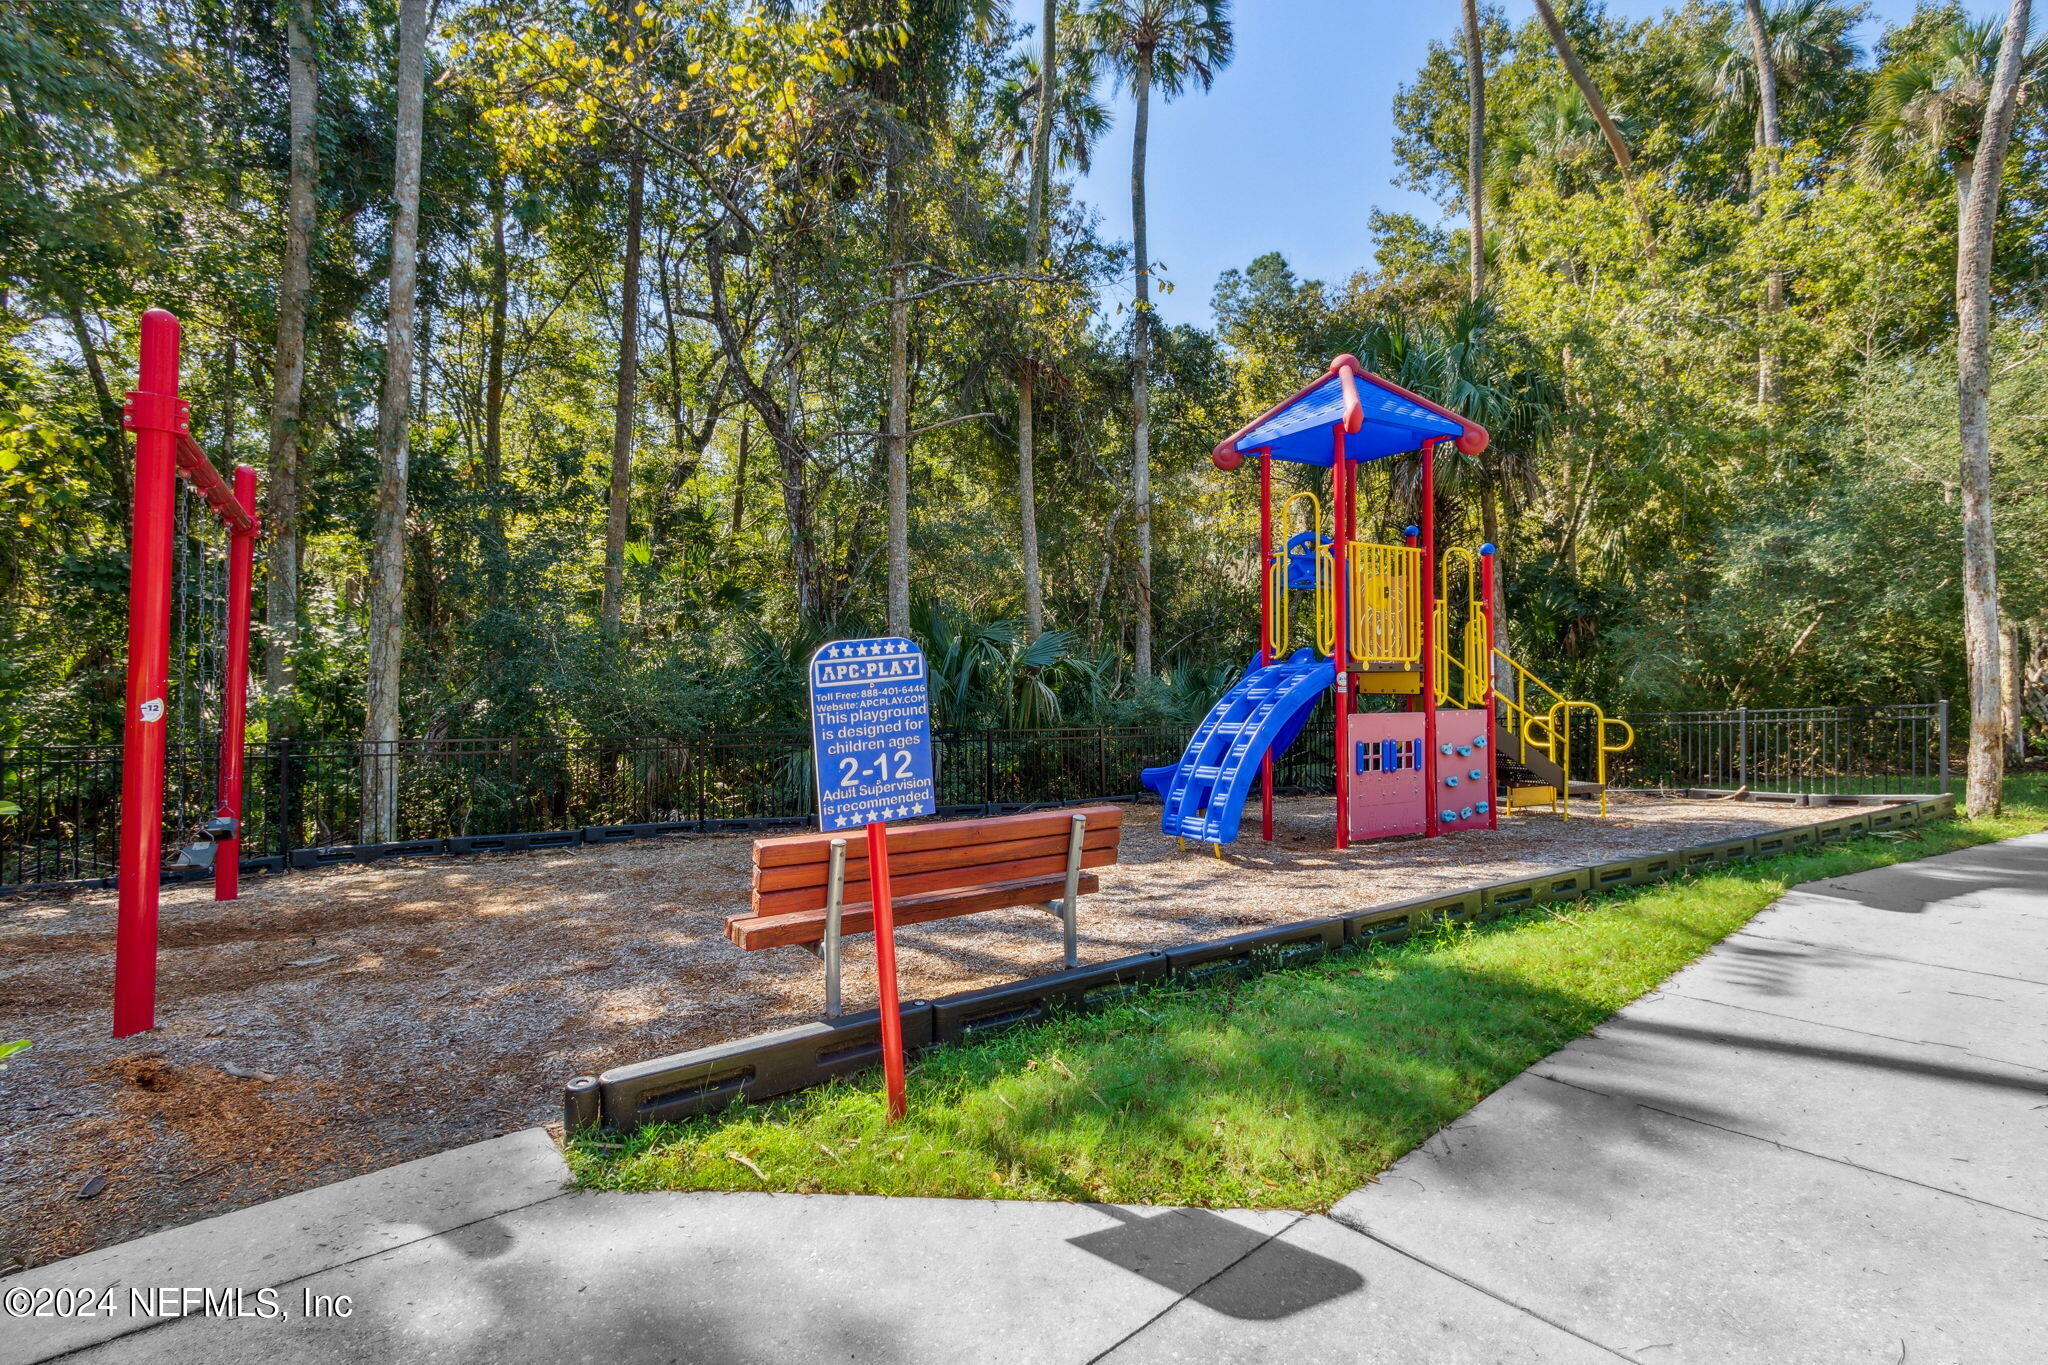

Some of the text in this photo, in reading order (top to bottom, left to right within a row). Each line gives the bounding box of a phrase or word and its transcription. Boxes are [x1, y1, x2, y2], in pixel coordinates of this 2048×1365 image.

[816, 685, 925, 702] Toll Free: 888-401-6446
[816, 695, 926, 713] Website: APCPLAY.COM
[818, 703, 926, 725] This playground
[822, 719, 924, 740] is designed for
[828, 735, 920, 755] children ages
[839, 750, 913, 787] 2-12
[823, 777, 931, 802] Adult Supervision
[824, 790, 933, 815] is recommended.
